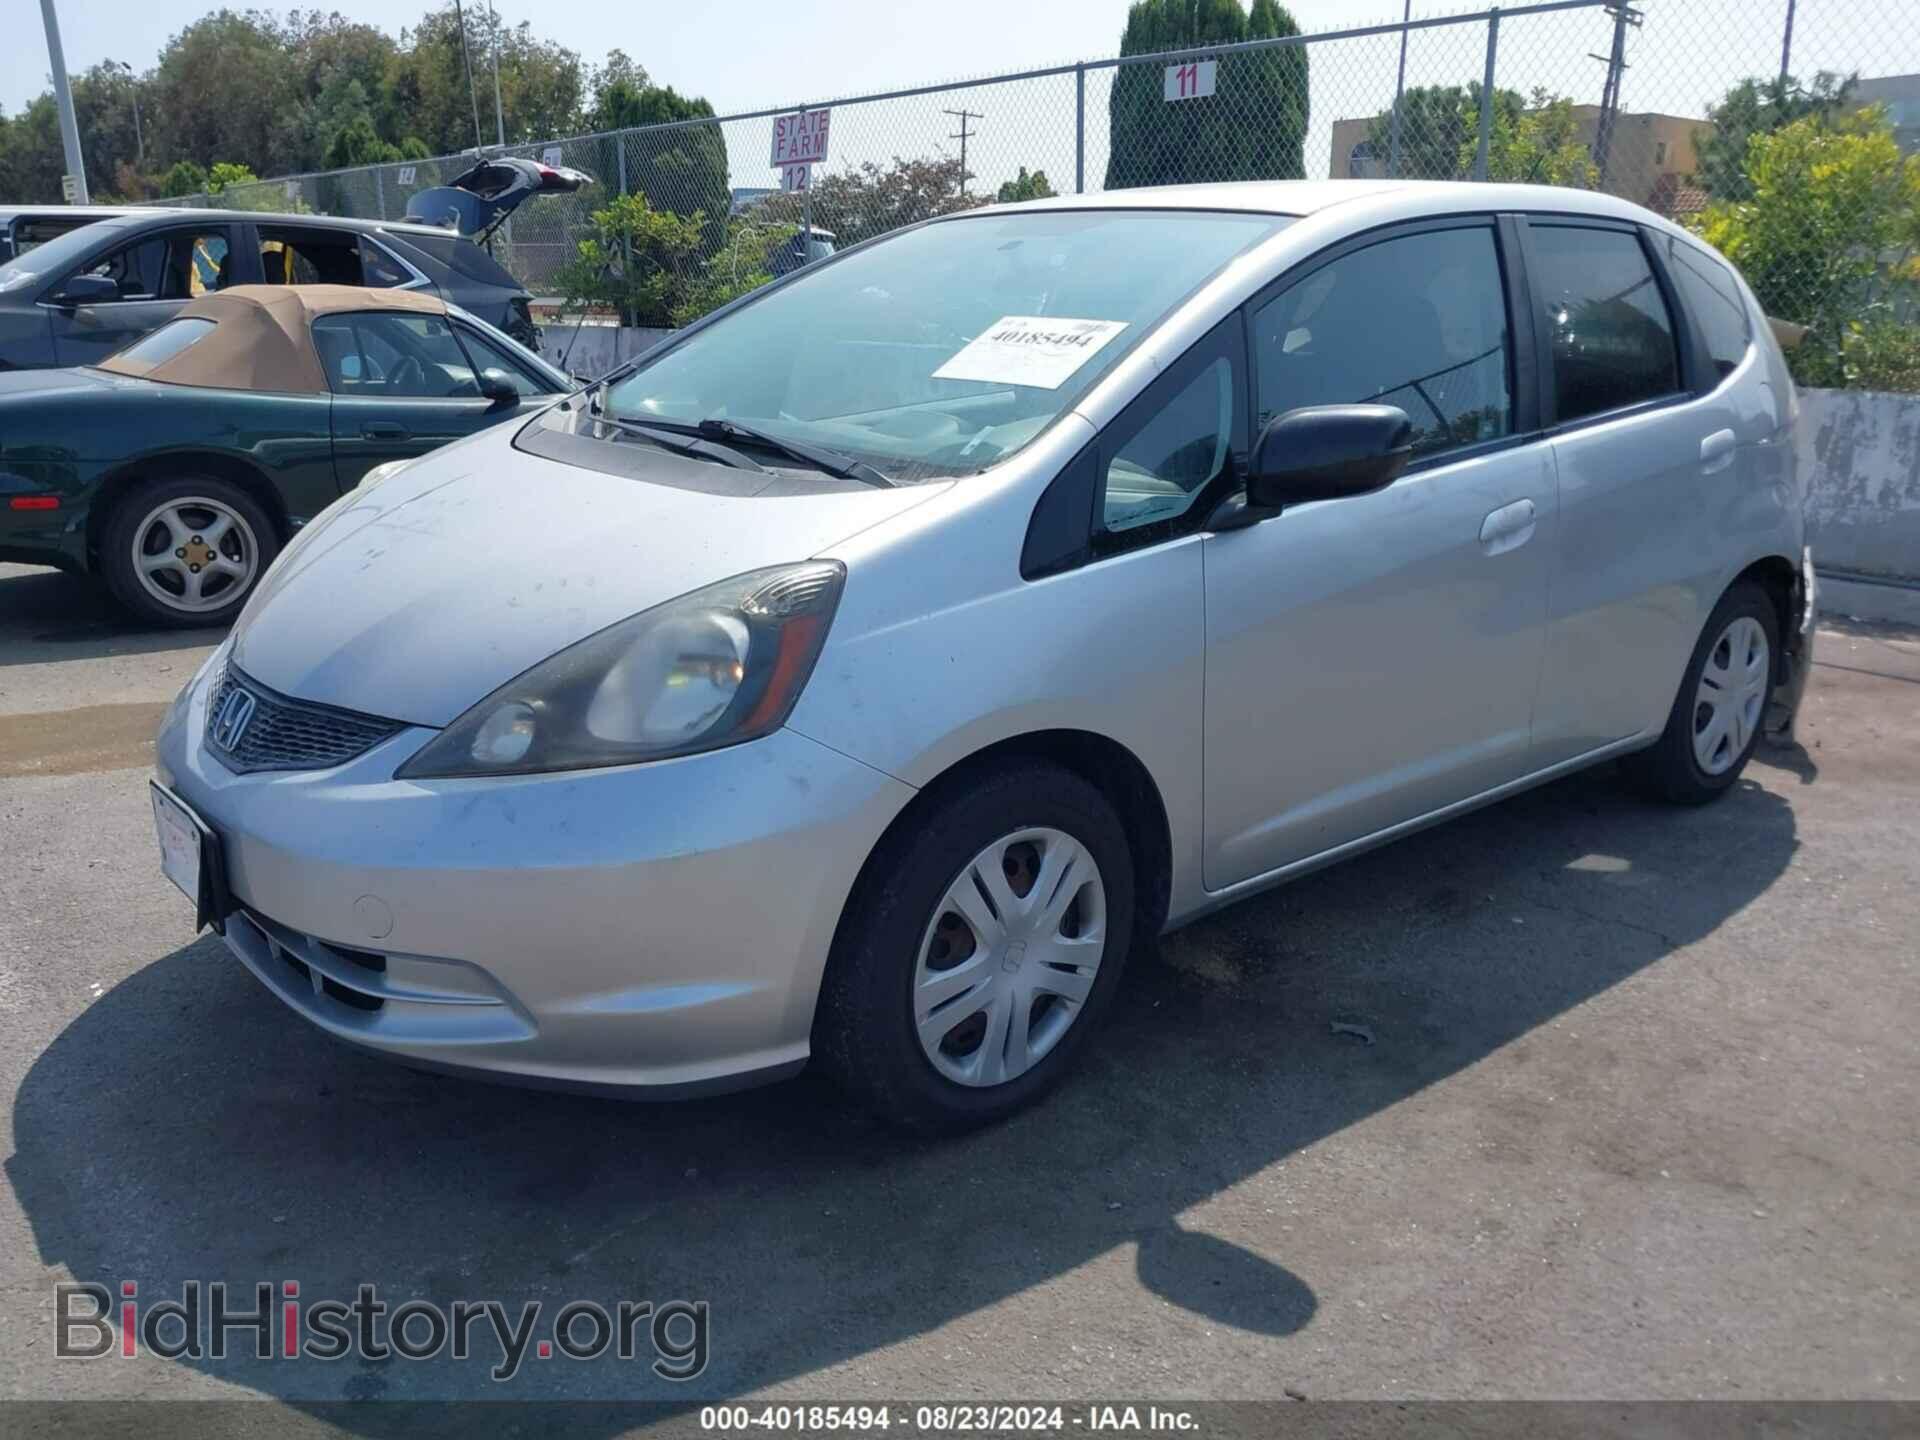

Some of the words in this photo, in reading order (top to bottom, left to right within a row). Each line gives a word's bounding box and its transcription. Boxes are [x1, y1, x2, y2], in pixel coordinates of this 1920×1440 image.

[1176, 64, 1198, 97] 11
[776, 110, 828, 136] STATE
[776, 132, 825, 158] FARM
[786, 166, 807, 190] 12
[991, 329, 1095, 347] 40185494
